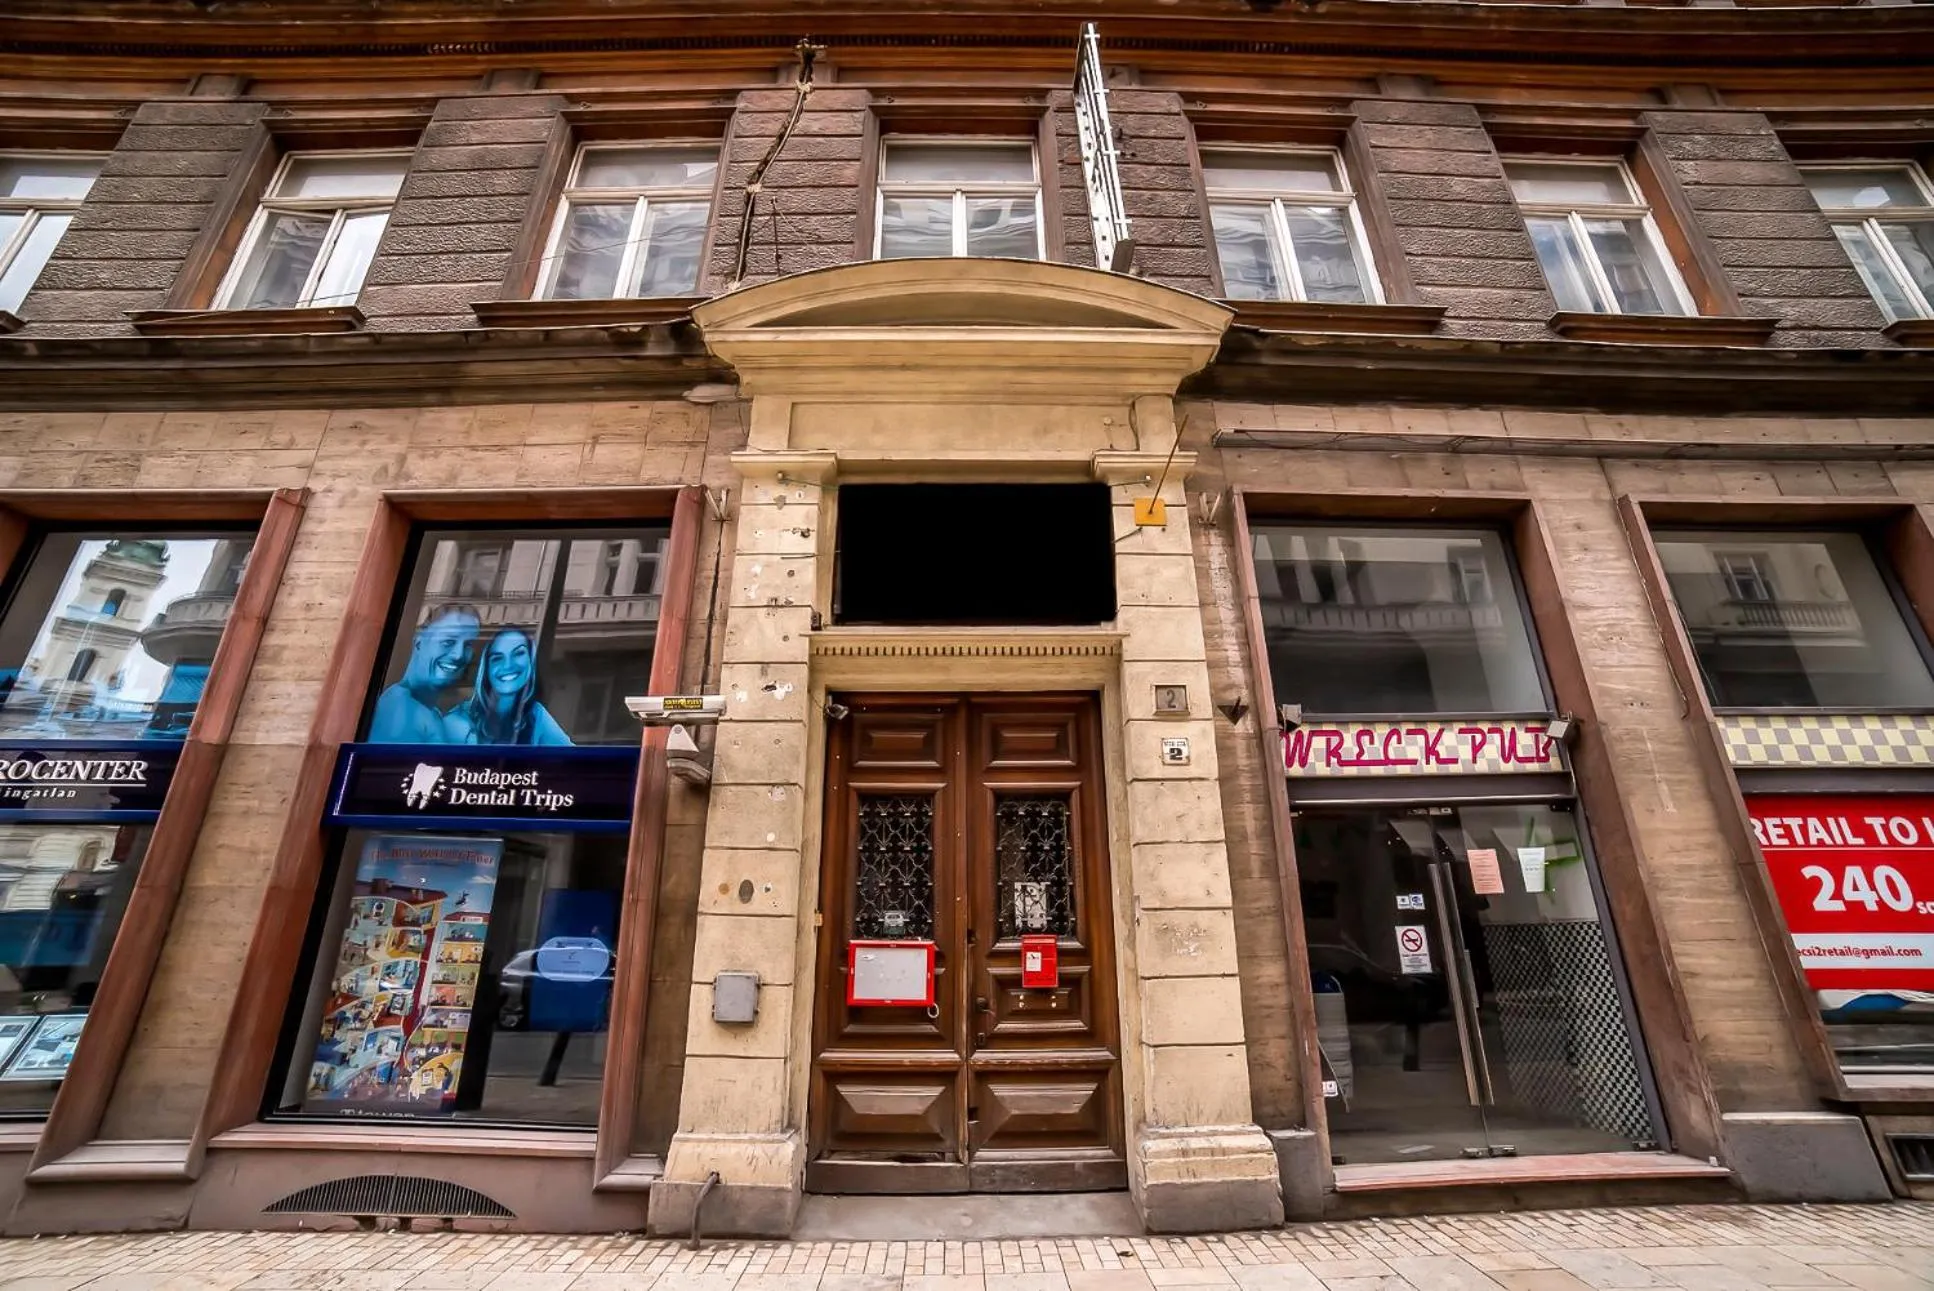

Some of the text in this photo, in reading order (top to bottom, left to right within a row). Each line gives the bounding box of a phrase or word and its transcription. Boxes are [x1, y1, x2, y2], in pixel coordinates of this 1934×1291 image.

[1166, 688, 1177, 709] 2
[1168, 747, 1183, 761] 2
[1279, 726, 1557, 769] WRECK PUB
[452, 767, 539, 790] Budapest
[3, 787, 77, 800] ingatlan
[448, 788, 574, 811] Dental Trips
[1863, 816, 1919, 846] TO
[1800, 864, 1914, 912] 240
